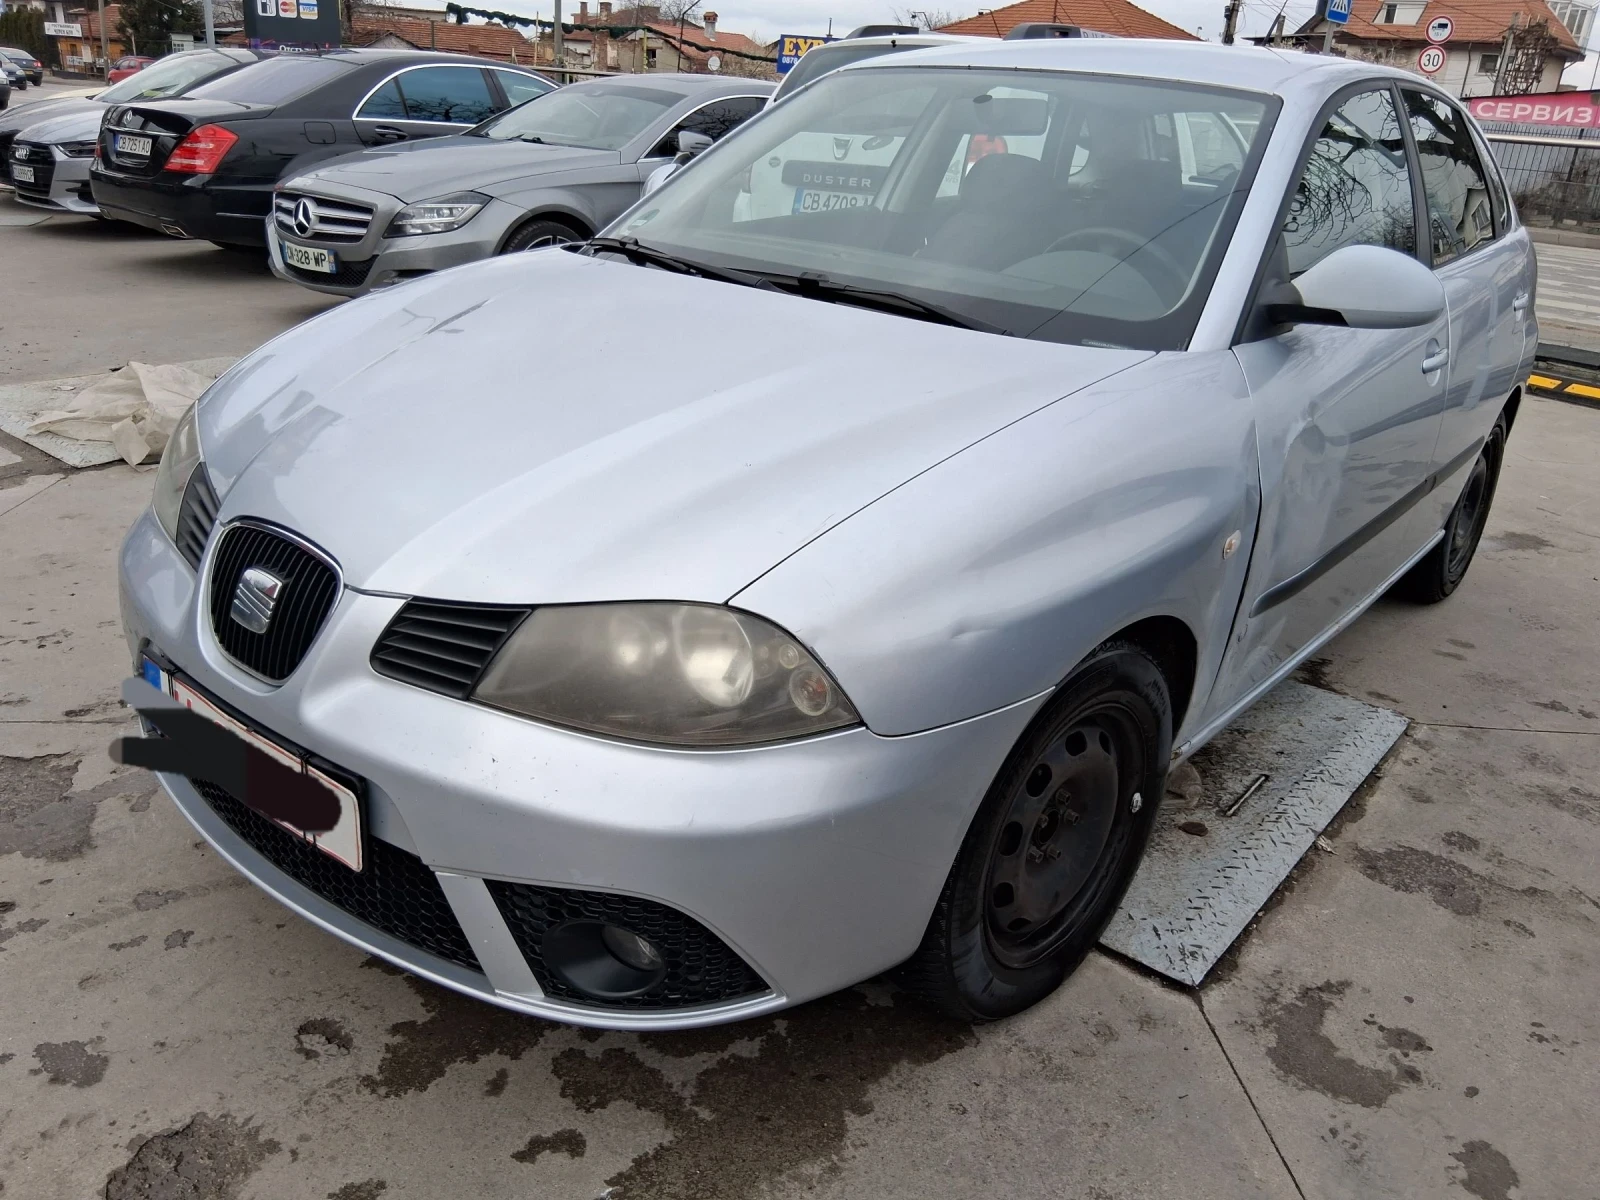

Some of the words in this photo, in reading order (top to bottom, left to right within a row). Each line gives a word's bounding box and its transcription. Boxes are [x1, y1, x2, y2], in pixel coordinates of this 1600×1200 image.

[1423, 53, 1440, 67] 30
[1476, 101, 1593, 124] СЕРВИЗ
[803, 173, 871, 188] DUSTER
